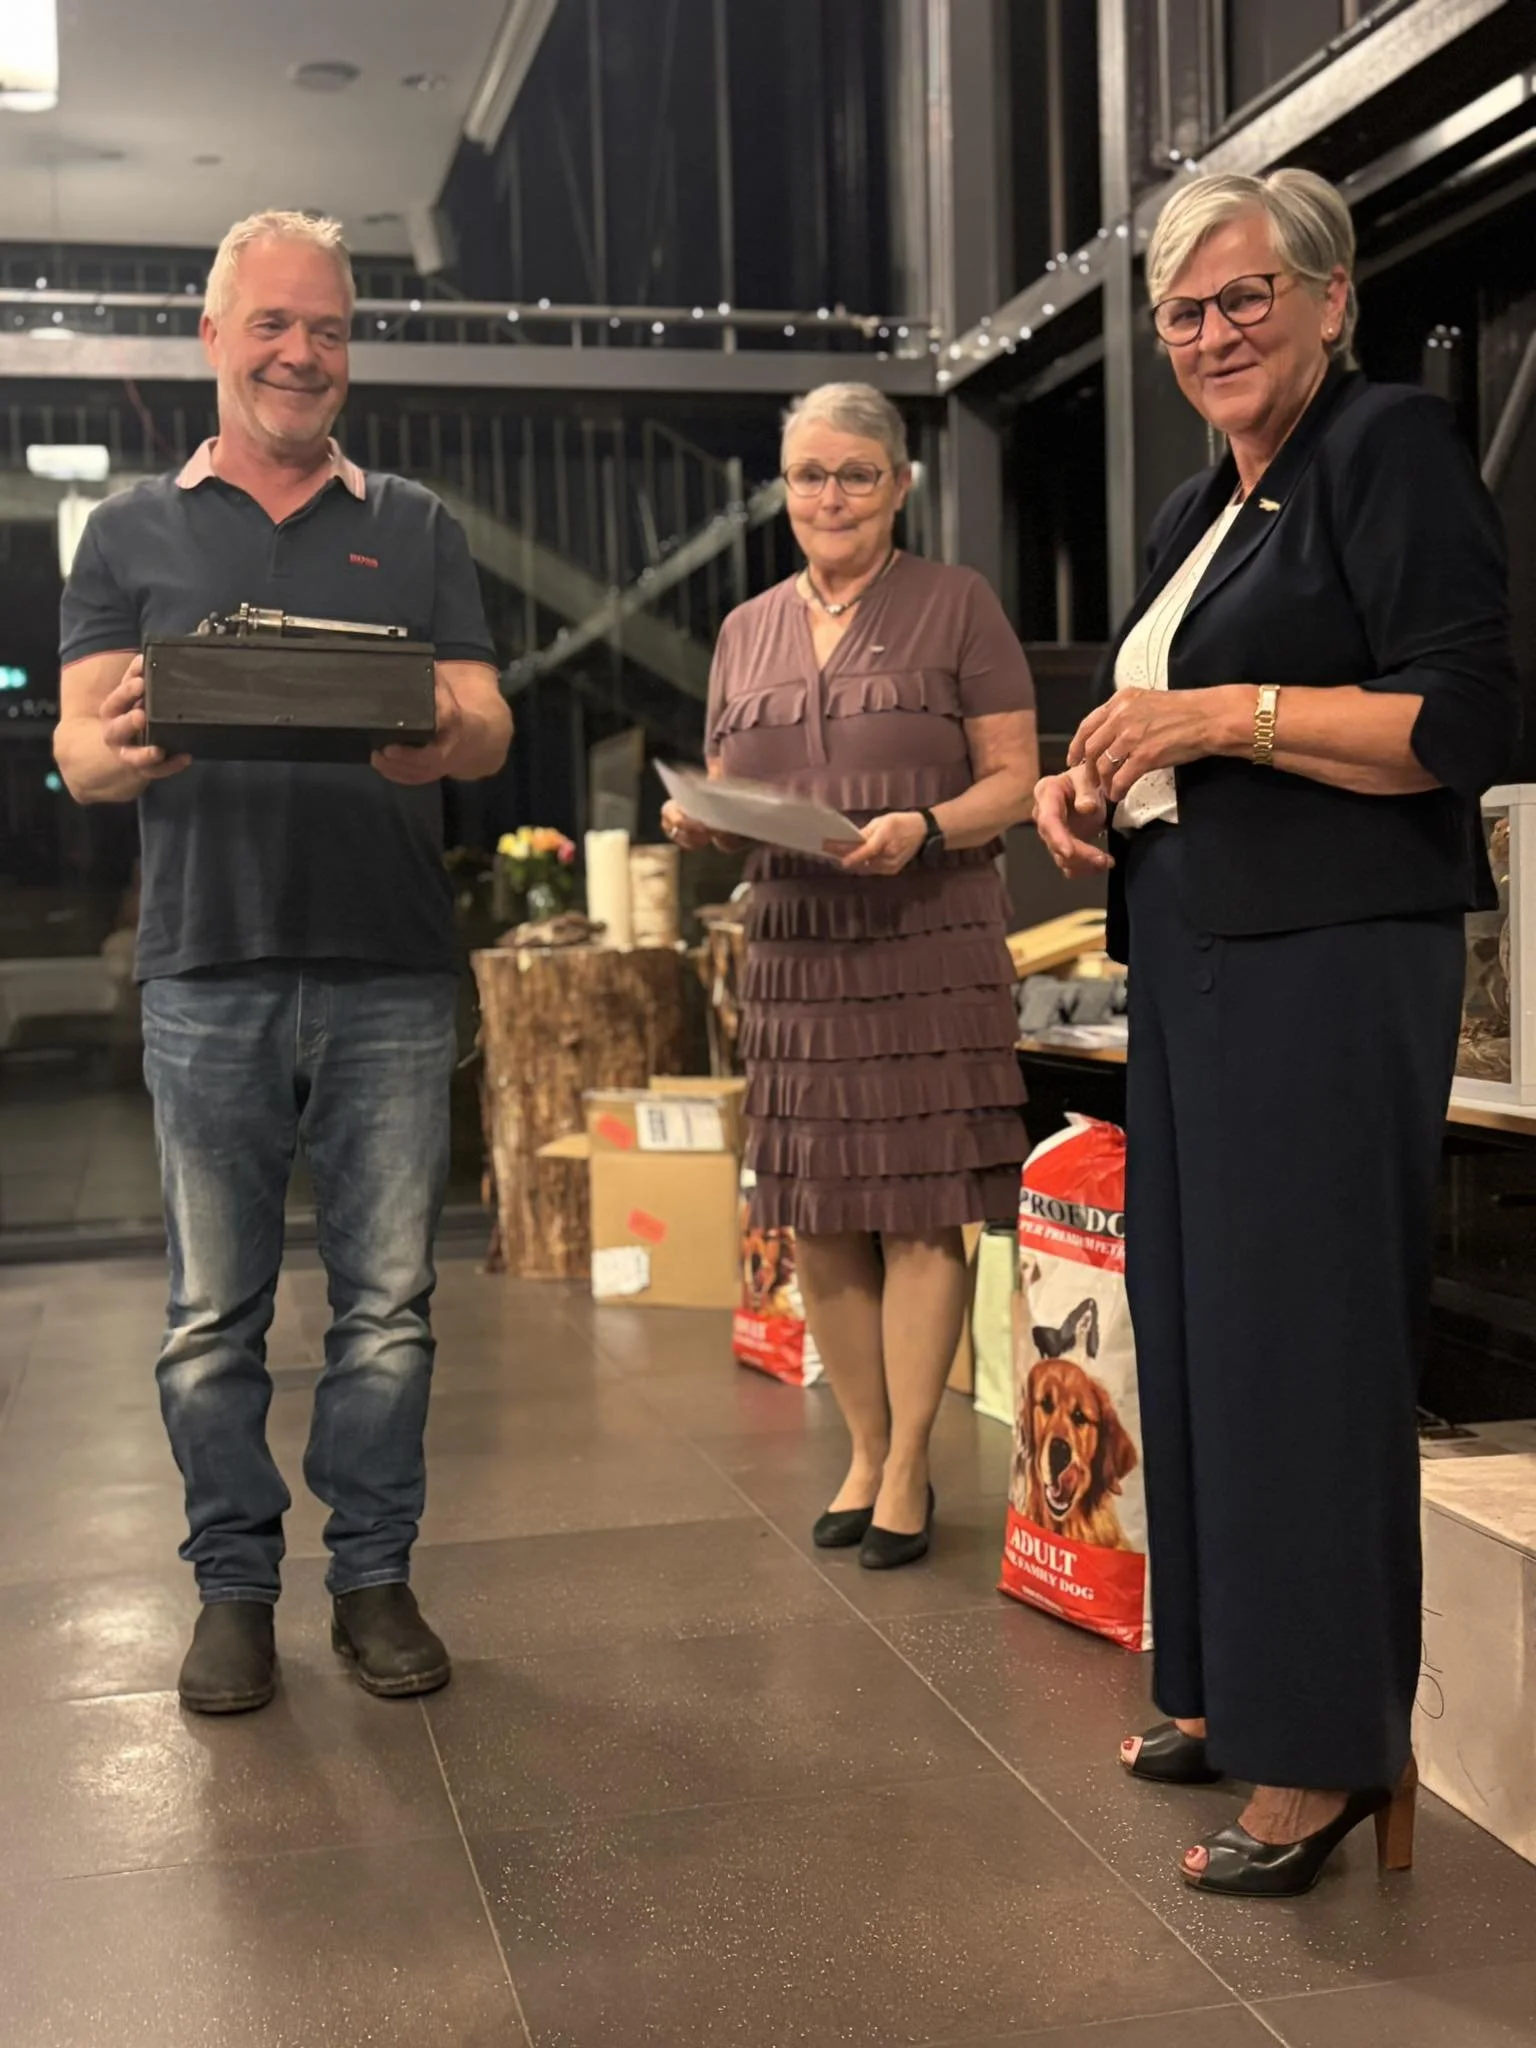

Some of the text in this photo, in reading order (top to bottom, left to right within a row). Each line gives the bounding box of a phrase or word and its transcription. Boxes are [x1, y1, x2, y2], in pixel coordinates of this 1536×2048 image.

[1010, 1526, 1077, 1577] ADULT
[1018, 1556, 1058, 1587] FAMILY
[1059, 1577, 1095, 1601] DOG
